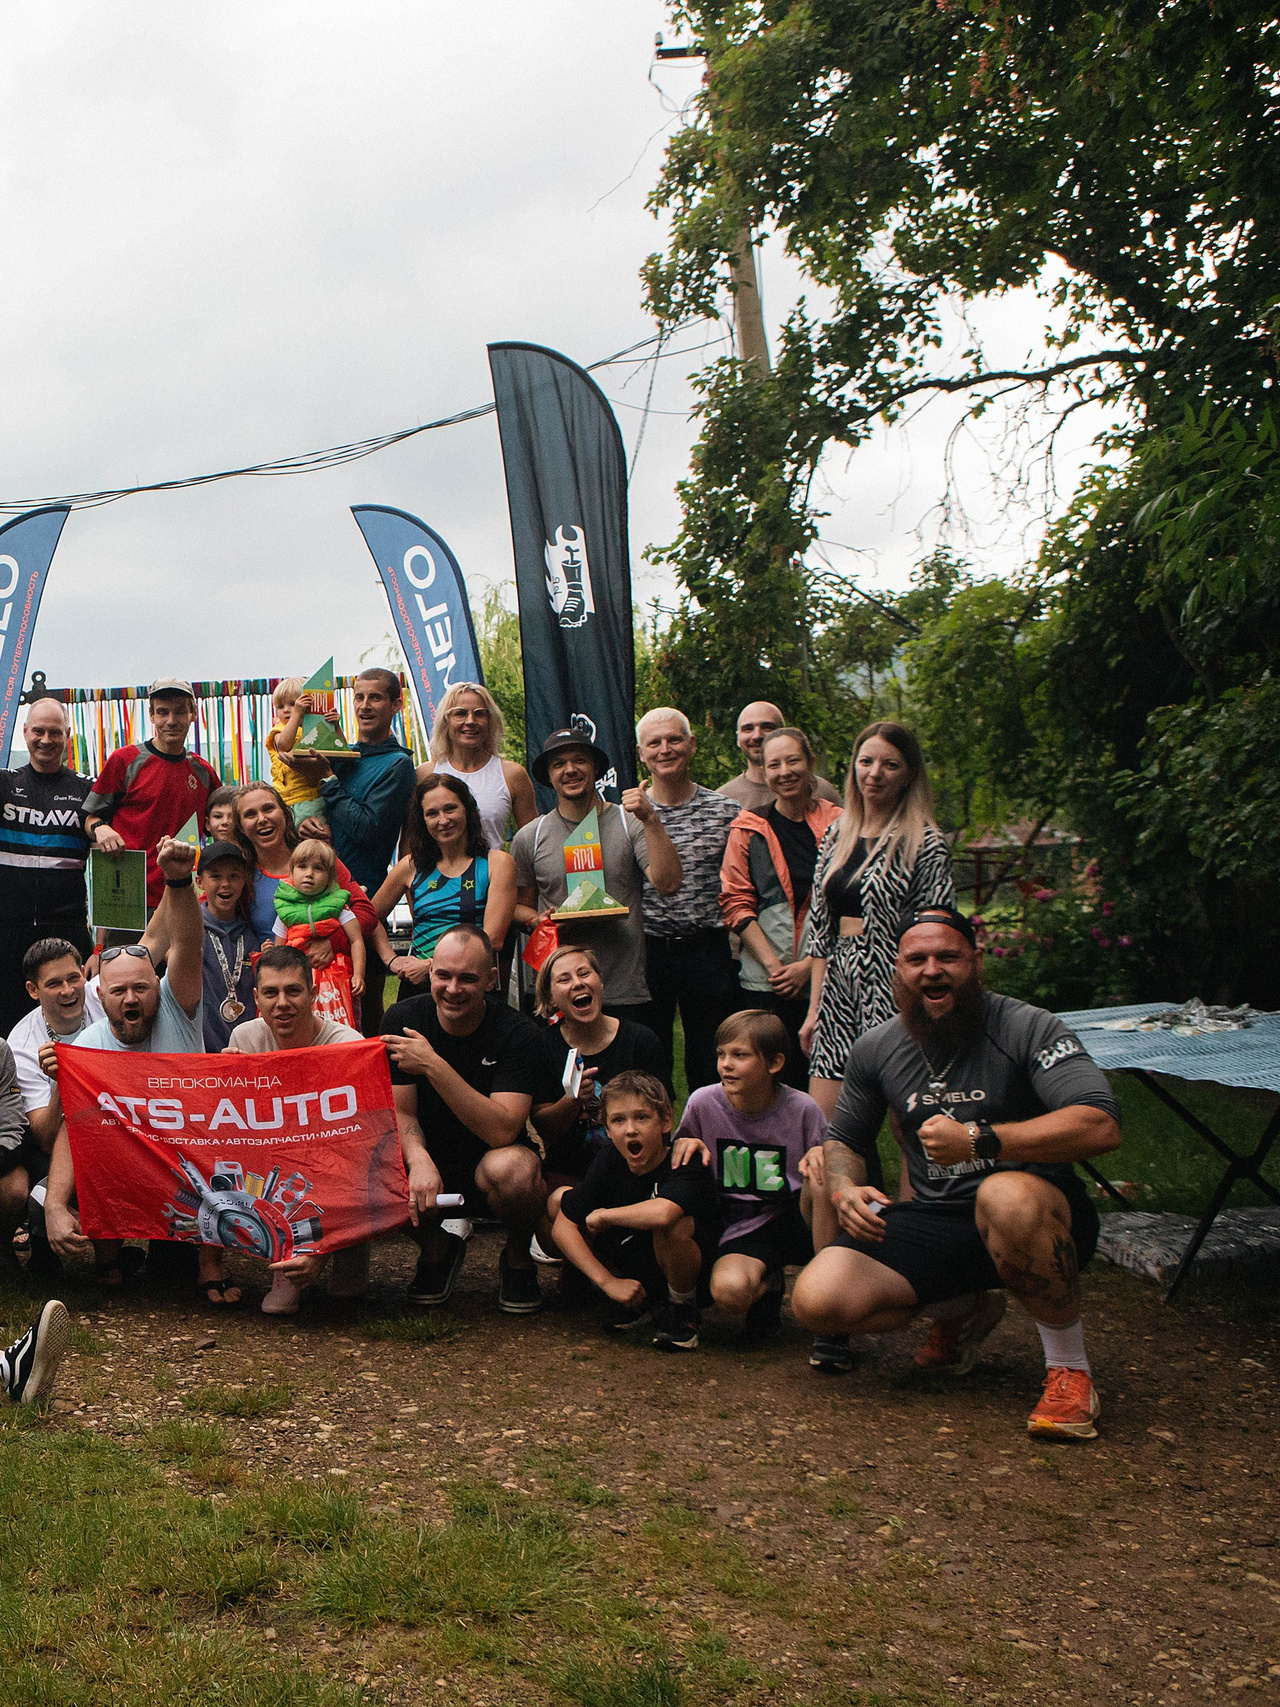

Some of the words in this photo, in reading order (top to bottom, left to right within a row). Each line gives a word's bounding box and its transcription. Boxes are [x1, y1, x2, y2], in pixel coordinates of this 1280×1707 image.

[4, 676, 16, 702] ТВОЯ
[11, 570, 39, 675] СУПЕРСПОСОБНОСТЬ
[2, 802, 81, 829] STRAVA
[147, 1076, 282, 1090] ВЕЛОКОМАНДА
[97, 1085, 358, 1131] ATS-AUTO
[225, 1132, 315, 1146] АВТОЗАПЧАСТИ
[320, 1123, 362, 1139] МАСЛА
